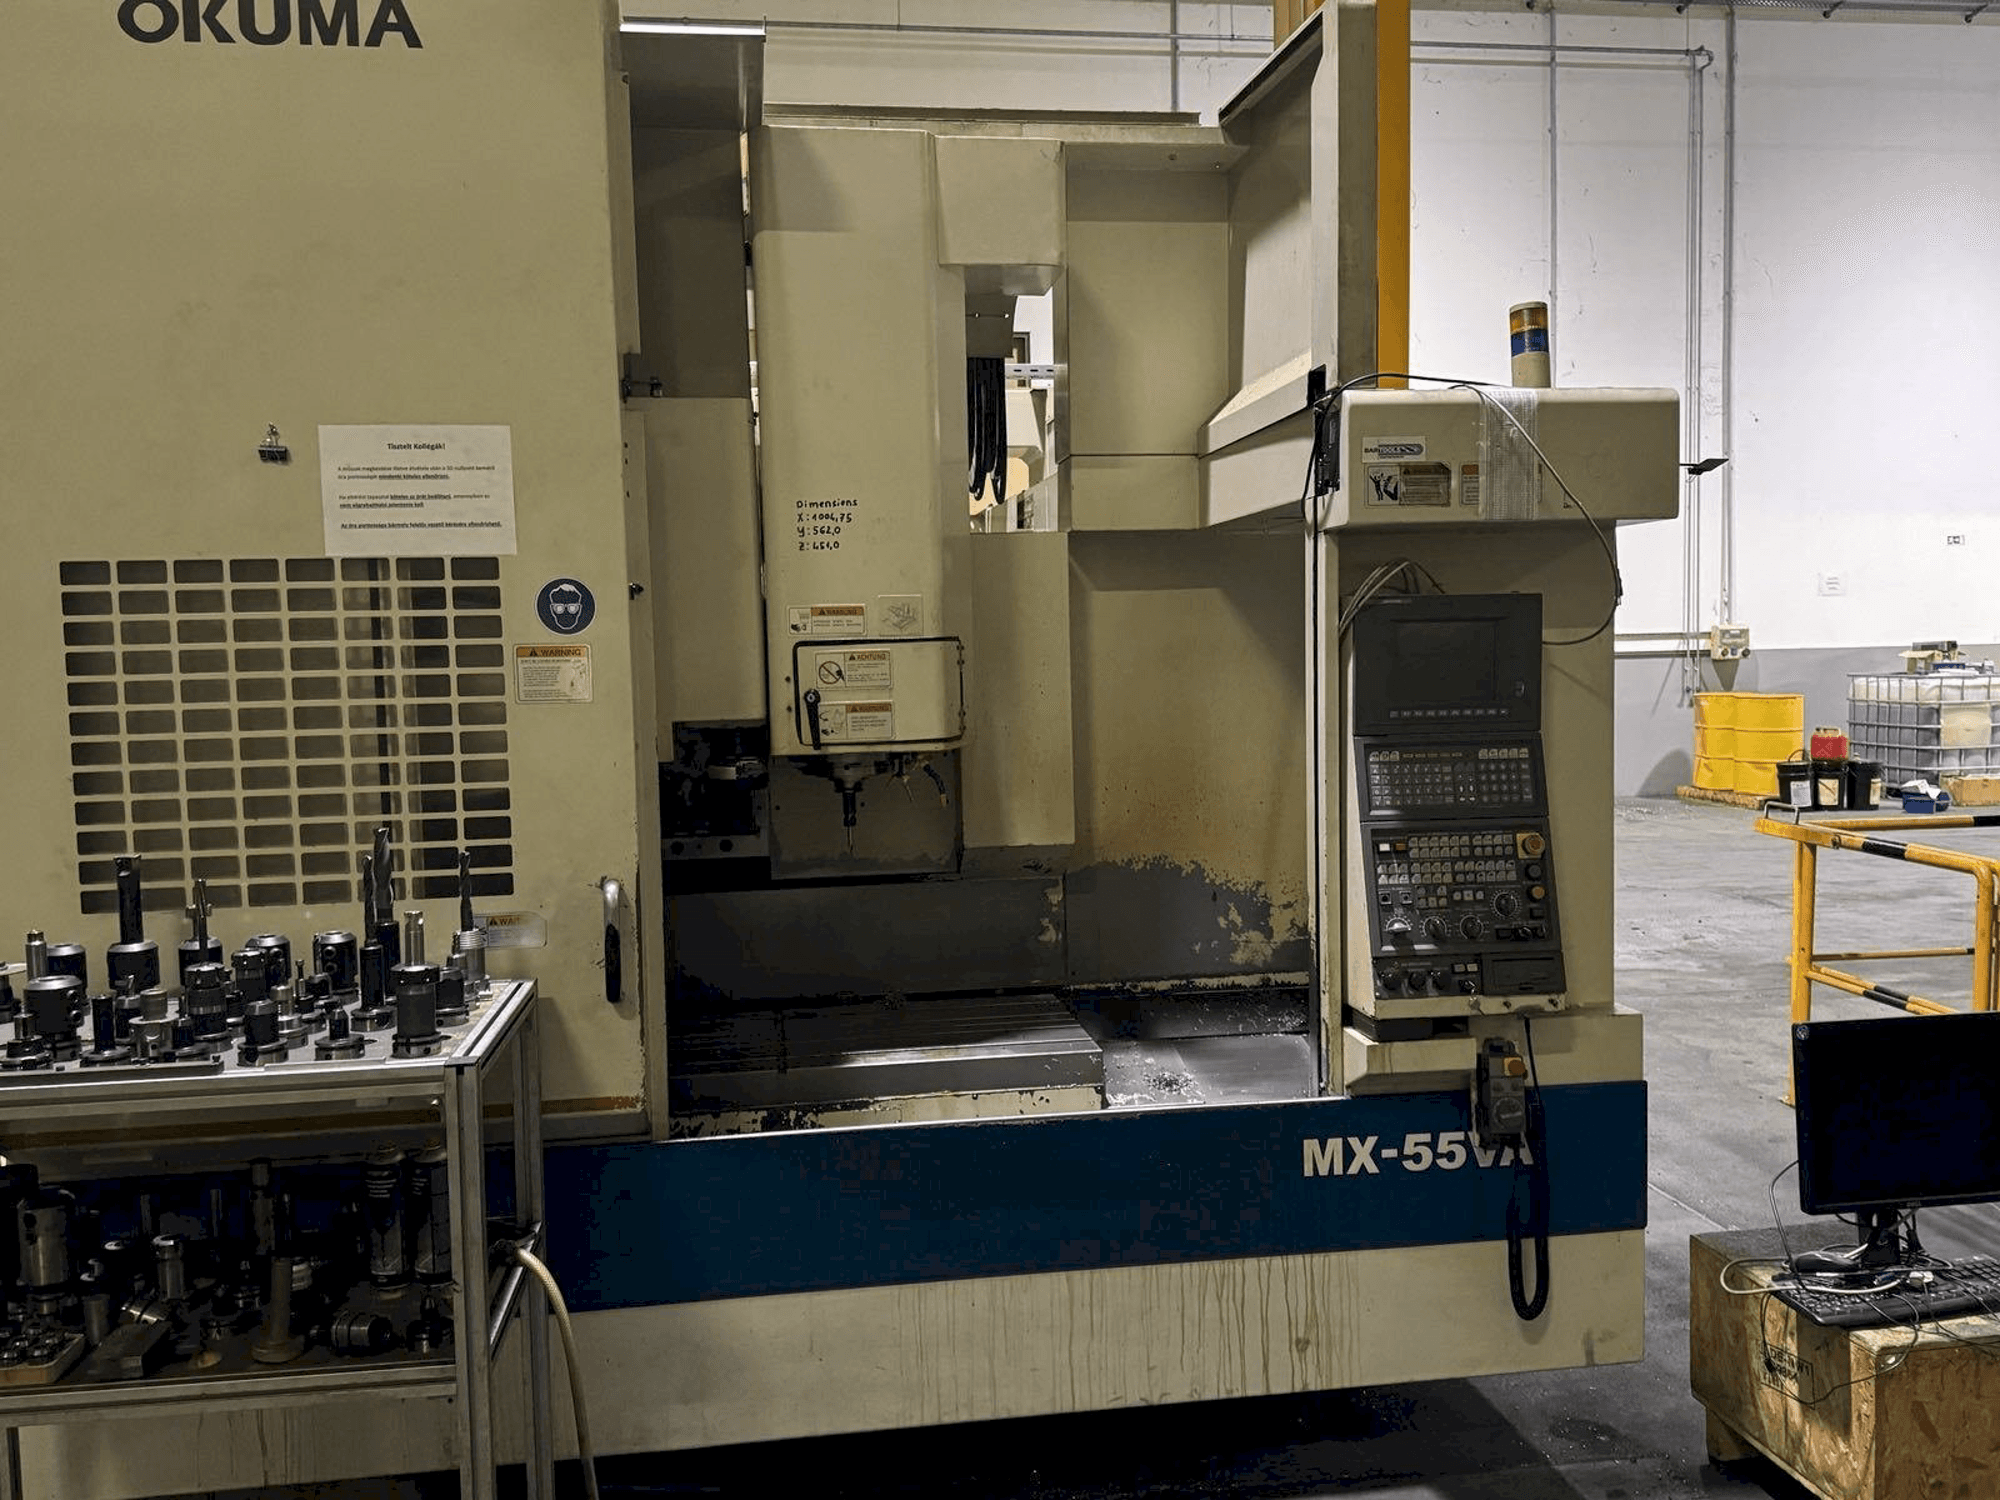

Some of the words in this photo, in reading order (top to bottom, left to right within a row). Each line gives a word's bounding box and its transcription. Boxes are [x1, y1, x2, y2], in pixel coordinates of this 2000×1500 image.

[117, 0, 423, 48] OKUMA
[796, 499, 858, 508] Dimensions
[541, 648, 582, 657] WARNING
